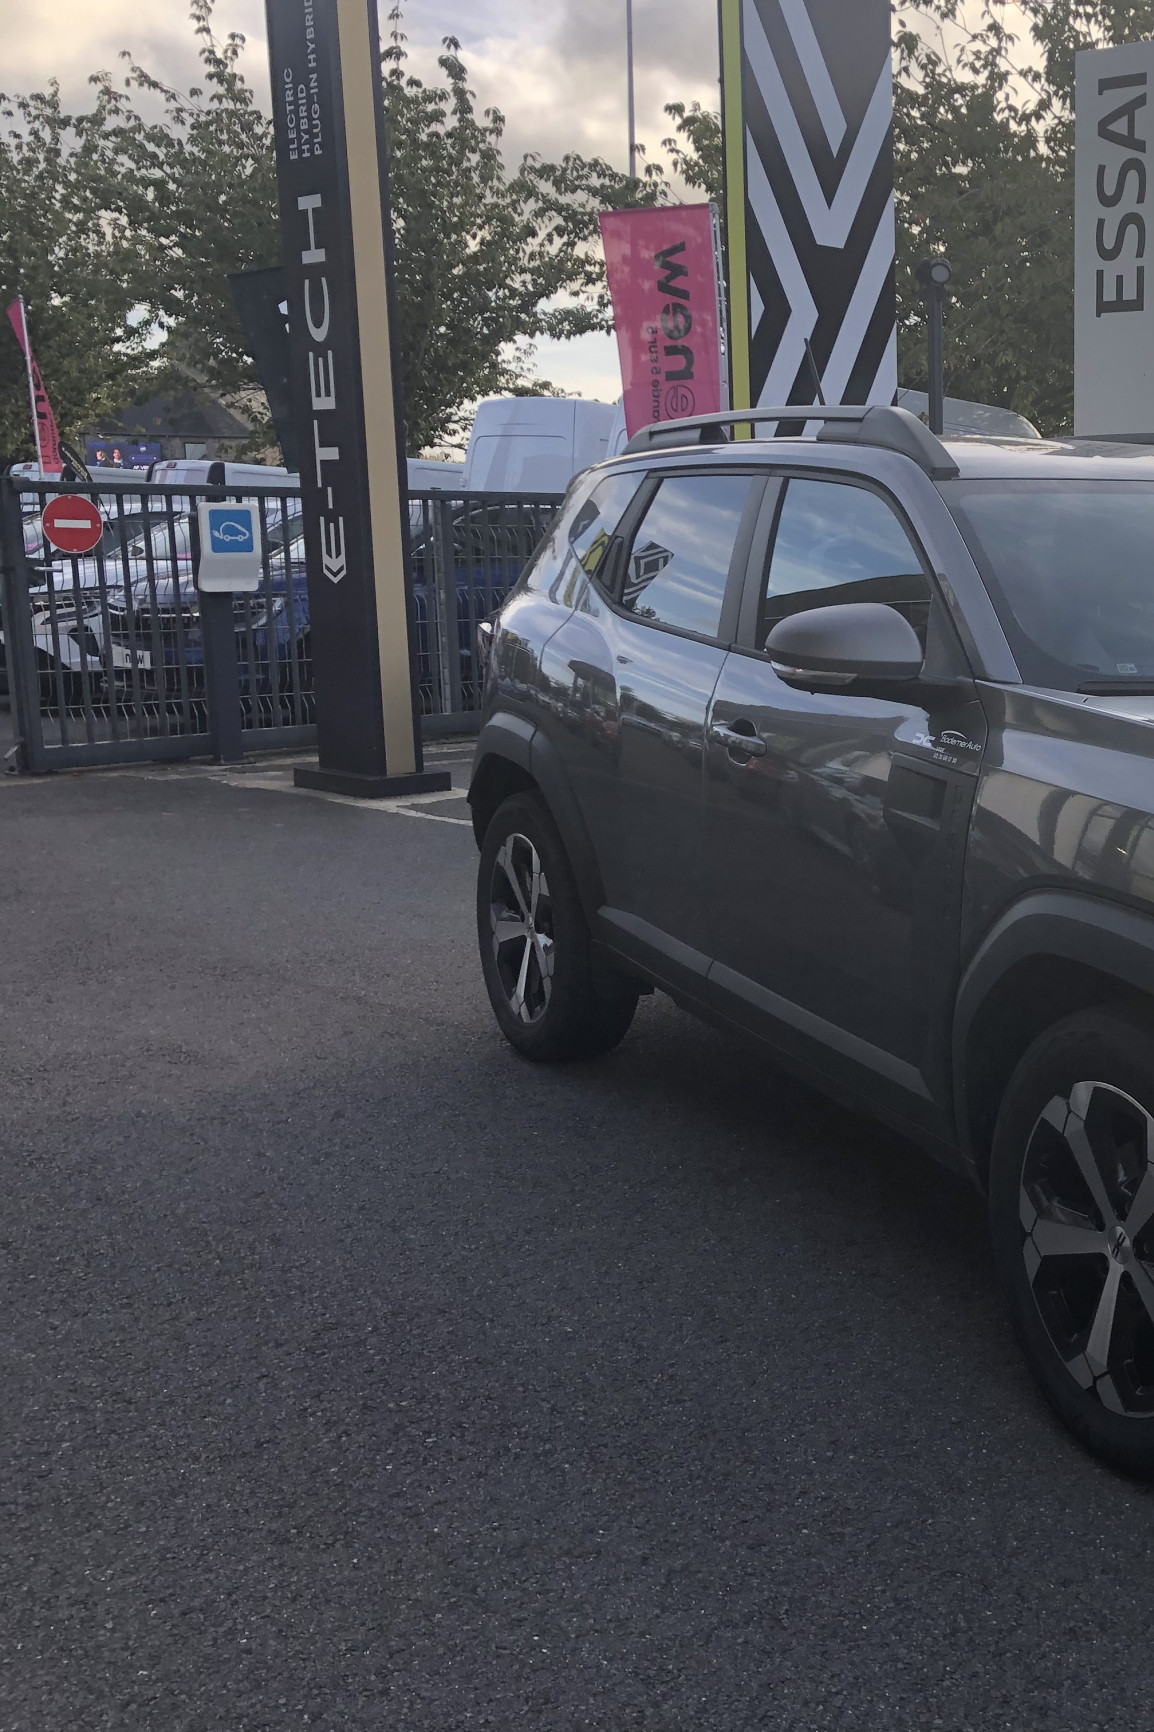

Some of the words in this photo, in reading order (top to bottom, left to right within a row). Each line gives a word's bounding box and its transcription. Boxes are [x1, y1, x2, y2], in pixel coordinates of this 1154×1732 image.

[284, 67, 299, 160] ELECTRIC
[298, 84, 311, 158] HYBRID
[309, 73, 323, 155] PLUG-IN
[1096, 72, 1147, 318] ESSAI
[297, 193, 347, 584] E-TECH
